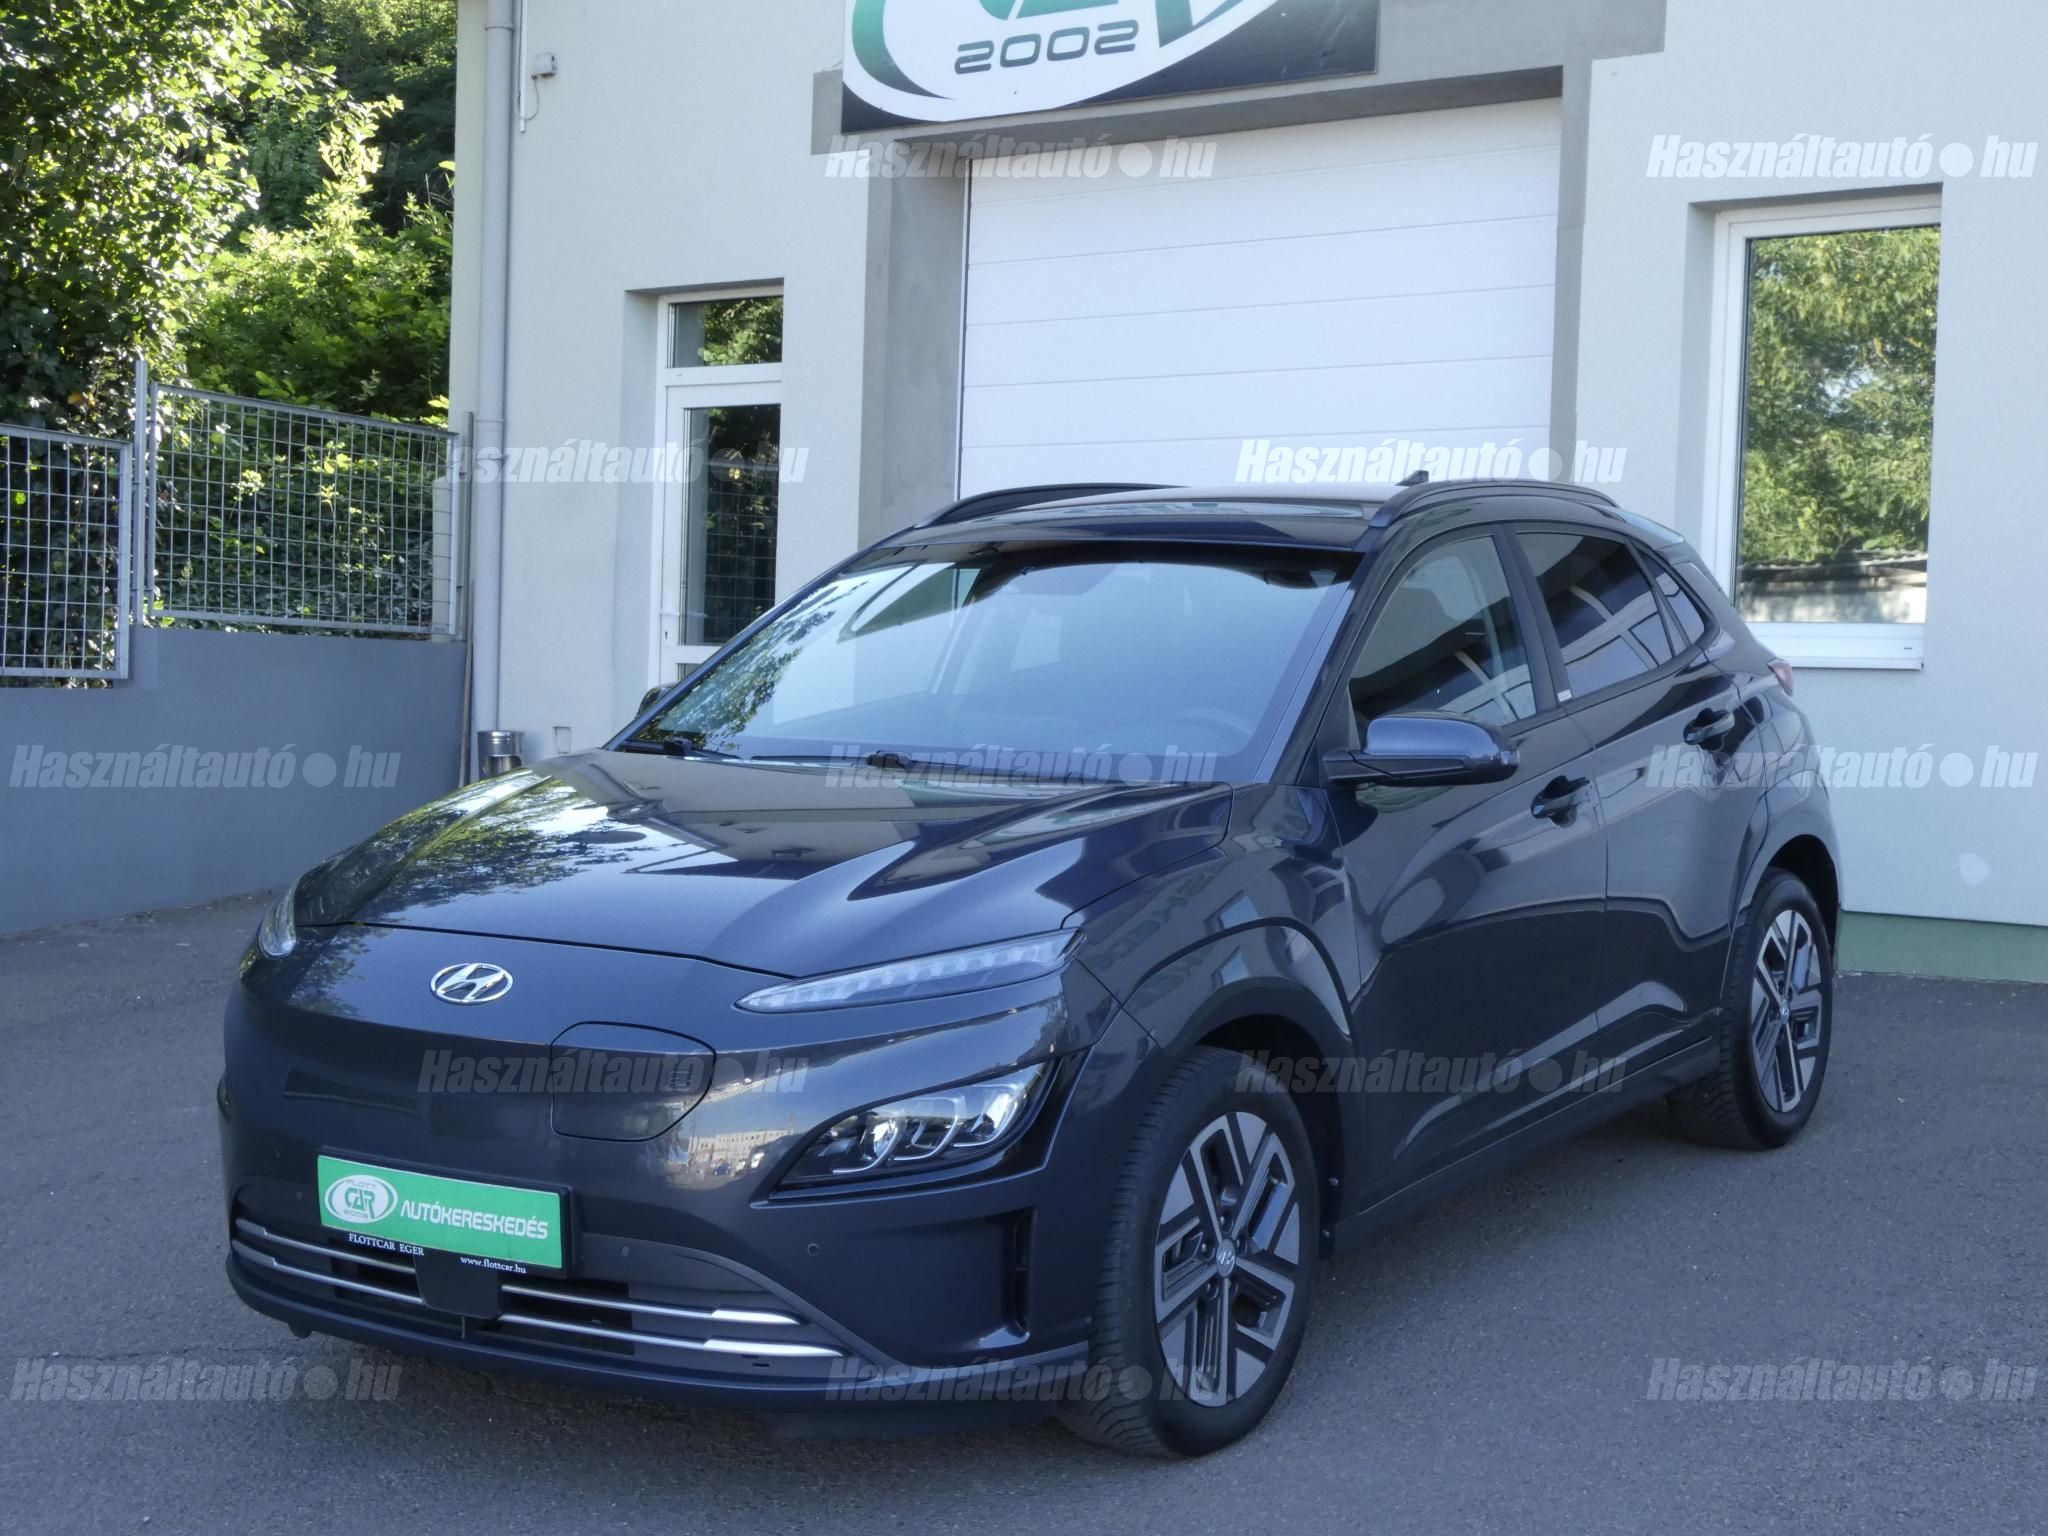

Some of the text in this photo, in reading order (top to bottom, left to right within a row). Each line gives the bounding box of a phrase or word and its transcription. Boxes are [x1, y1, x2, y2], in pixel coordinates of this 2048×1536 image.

[954, 19, 1139, 75] 2002
[400, 1199, 549, 1240] AUTÓKERESKEDÉS
[348, 1233, 425, 1257] FLOTTCAR EGER
[460, 1256, 528, 1274] www.flottcar.hu
